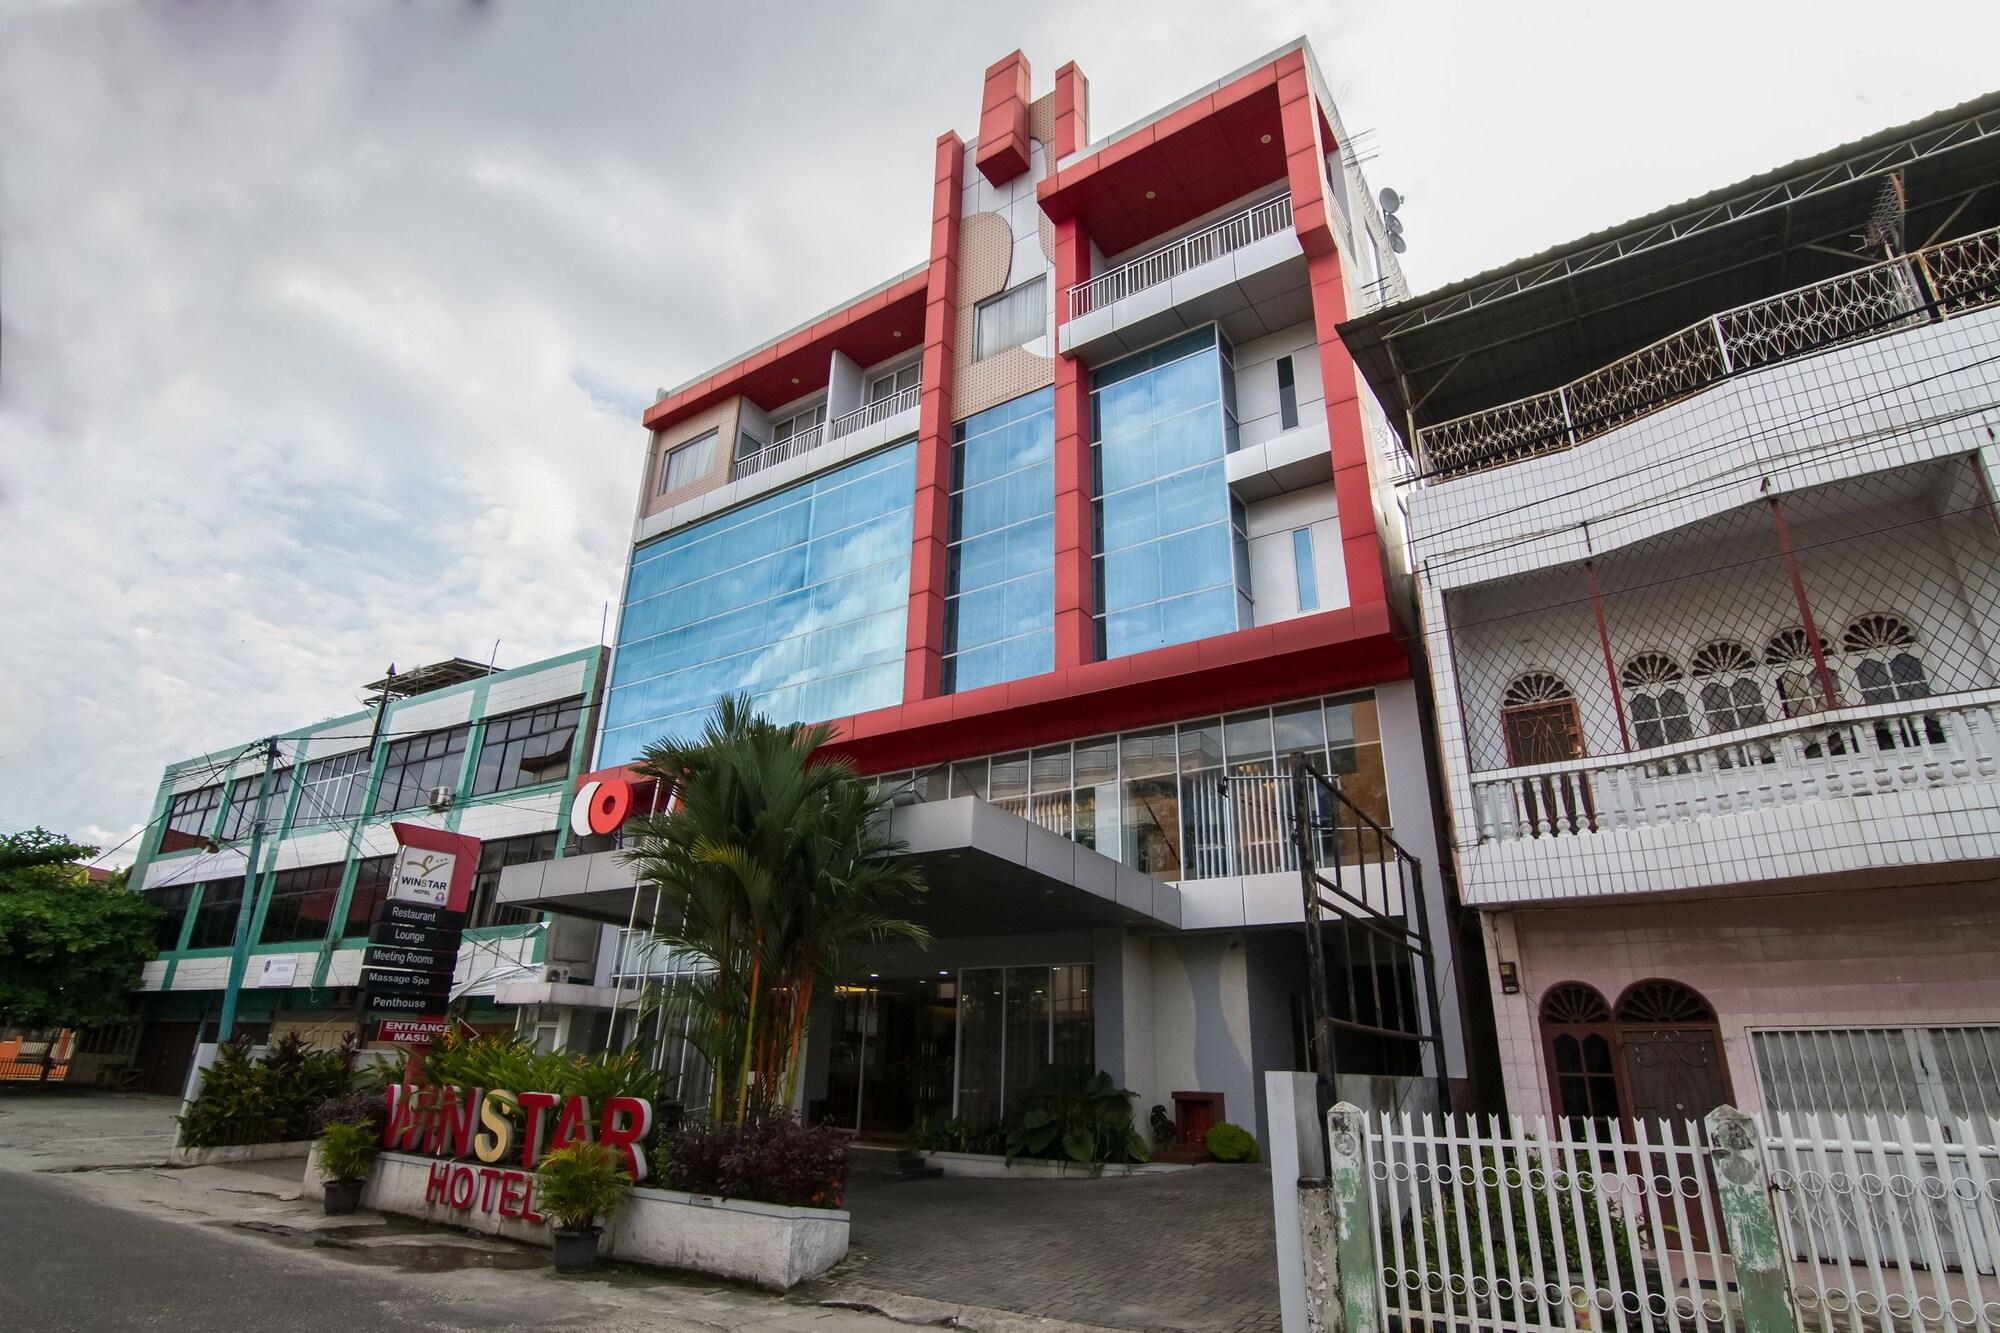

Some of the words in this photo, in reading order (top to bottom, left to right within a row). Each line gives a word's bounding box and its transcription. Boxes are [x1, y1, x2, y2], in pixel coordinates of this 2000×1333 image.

[401, 876, 446, 890] WINSTAR
[392, 906, 436, 922] Restaurant
[395, 929, 425, 943] Lounge
[373, 950, 405, 964] Meeting
[406, 953, 434, 965] Rooms
[369, 972, 410, 985] Massage
[411, 975, 430, 986] Spa
[373, 997, 426, 1008] Penthouse
[385, 1021, 452, 1033] ENTRANCE
[393, 1033, 432, 1042] MASU
[384, 1084, 652, 1182] WINSTAR
[425, 1161, 549, 1224] HOTEL
